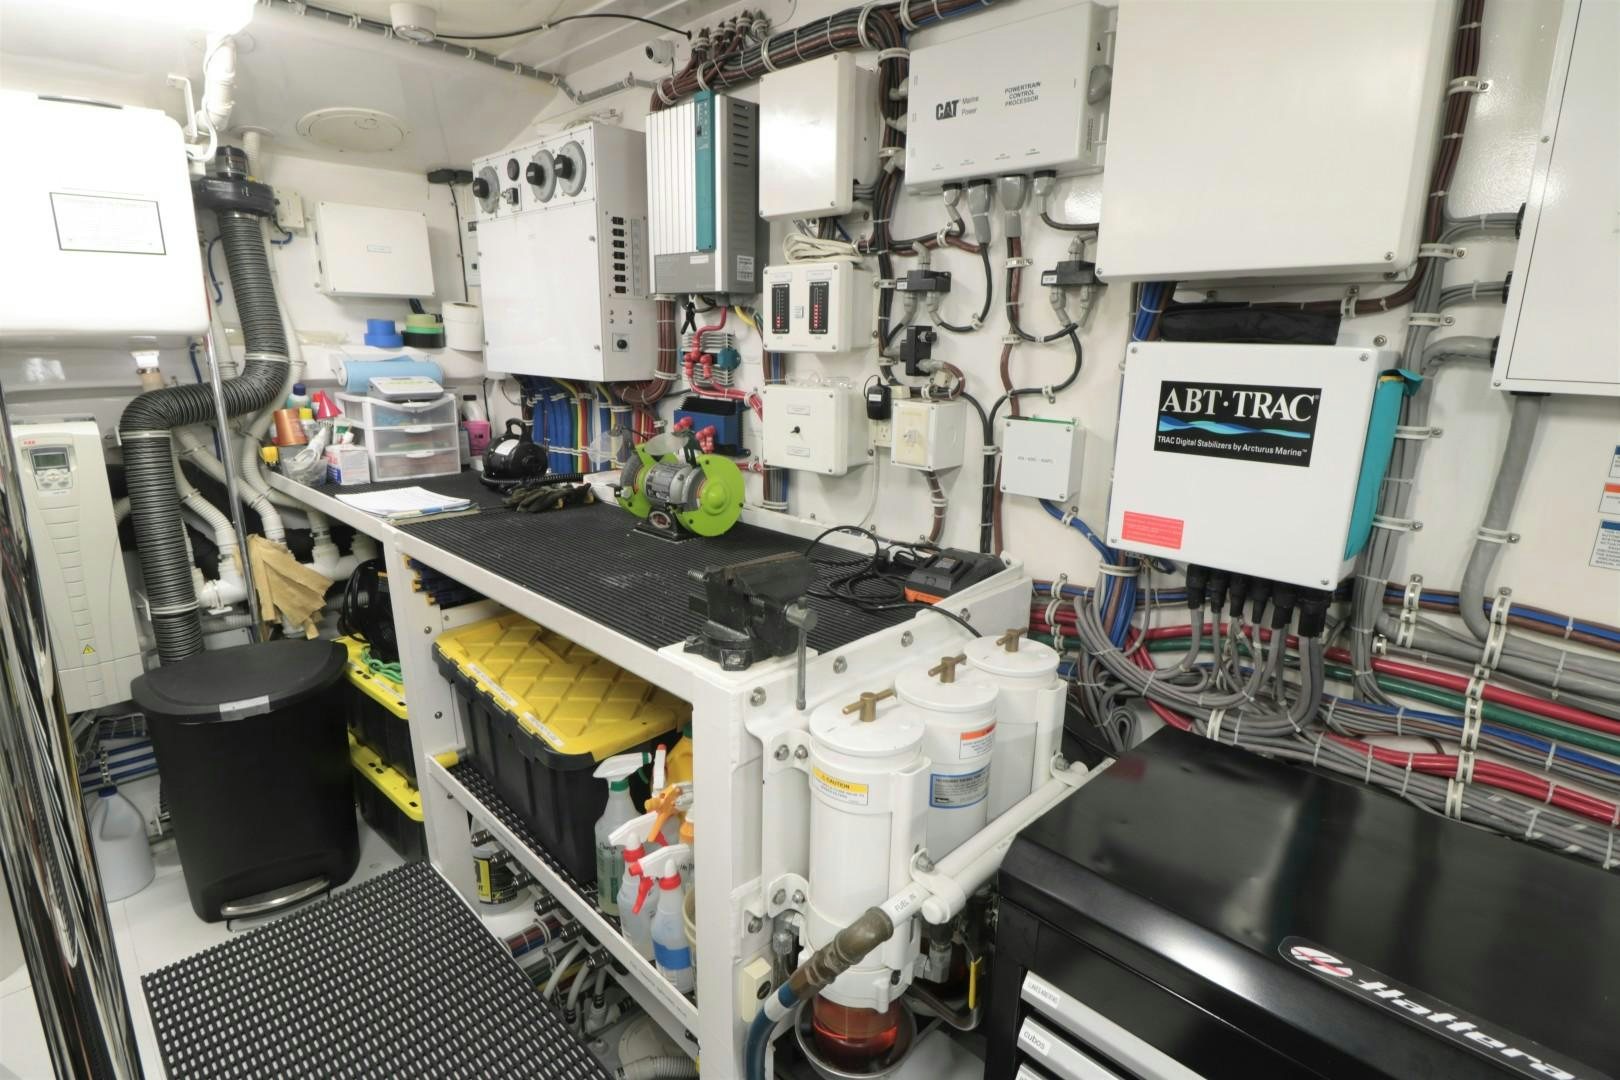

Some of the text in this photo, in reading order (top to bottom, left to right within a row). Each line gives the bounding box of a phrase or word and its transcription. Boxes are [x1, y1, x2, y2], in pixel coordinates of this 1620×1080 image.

[1004, 81, 1041, 95] POWERTRAIN
[1004, 95, 1039, 107] PROCESSOR
[1008, 90, 1035, 101] CONTROL
[936, 99, 959, 120] CAT
[962, 108, 977, 116] Power
[1157, 435, 1175, 445] TRAC
[1175, 437, 1197, 448] Digital
[1197, 439, 1232, 450] Stabilizers
[1232, 443, 1242, 452] by
[1243, 443, 1274, 454] Arcturus
[826, 776, 850, 789] CAUTION
[1358, 979, 1576, 1080] Hattera
